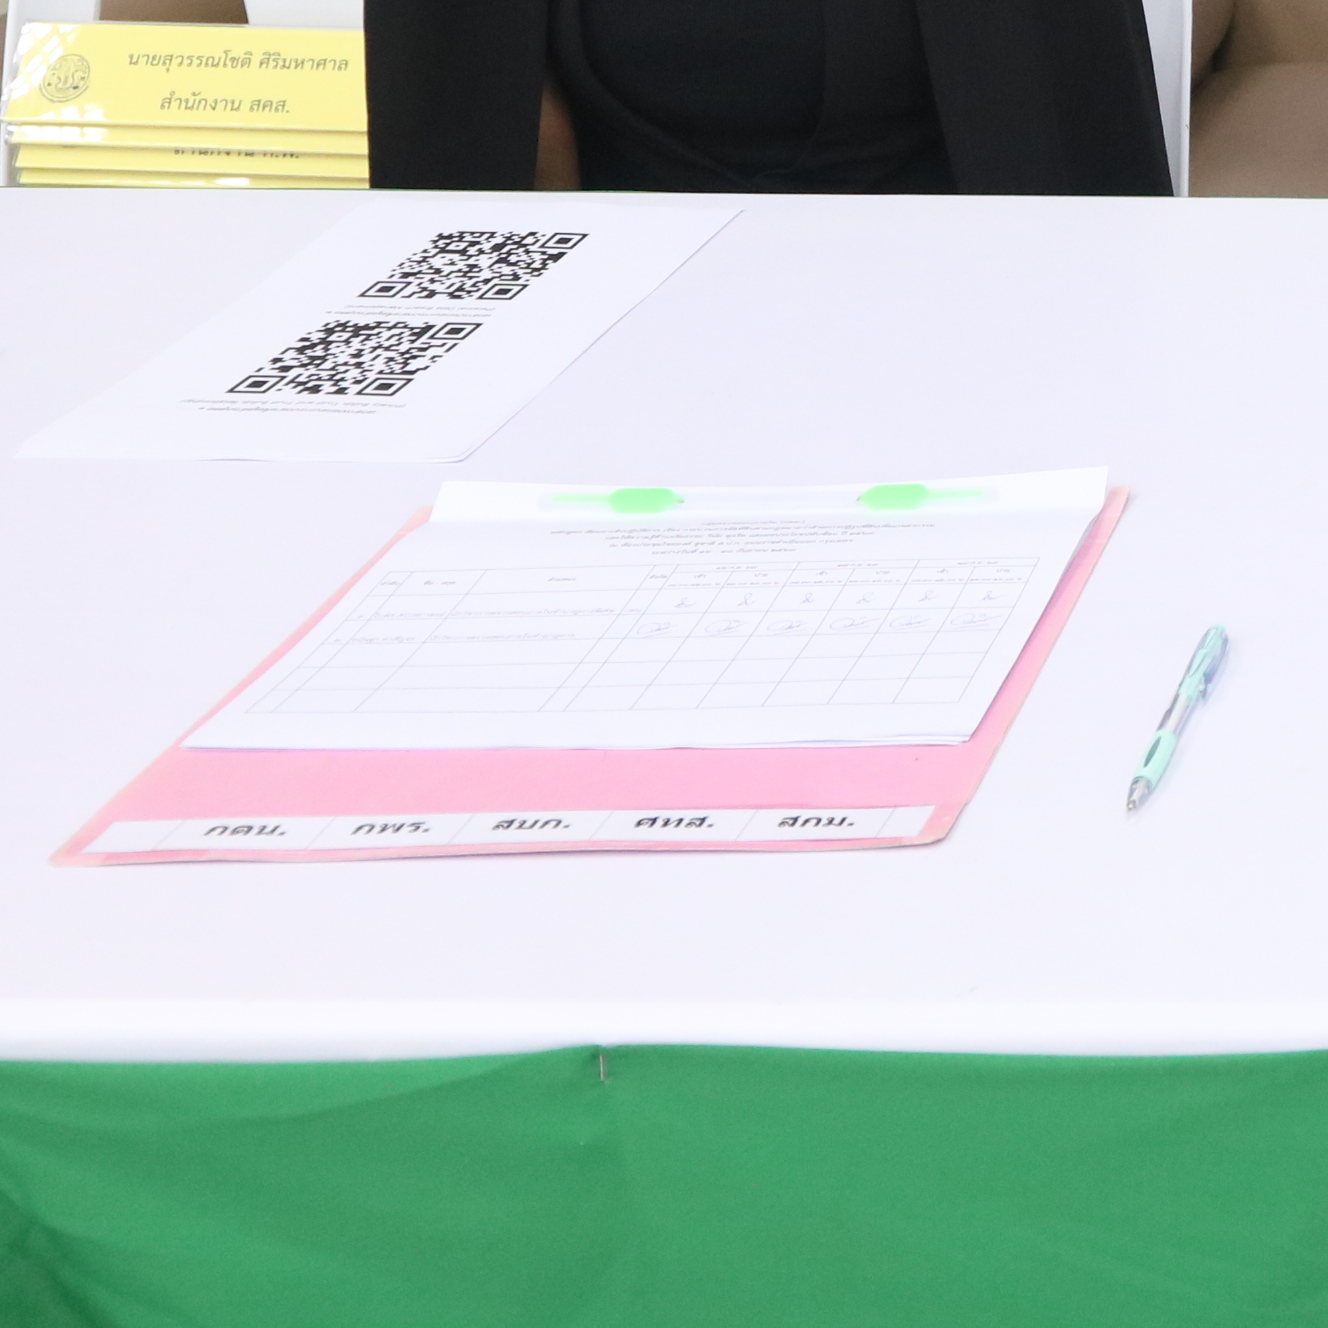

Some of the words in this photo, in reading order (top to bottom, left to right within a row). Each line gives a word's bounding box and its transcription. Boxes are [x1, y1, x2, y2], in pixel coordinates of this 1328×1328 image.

[258, 51, 348, 72] ศิริมหาศาล
[160, 90, 242, 112] สำนักงาน
[349, 821, 432, 836] กพร.
[491, 817, 571, 831] สบก.
